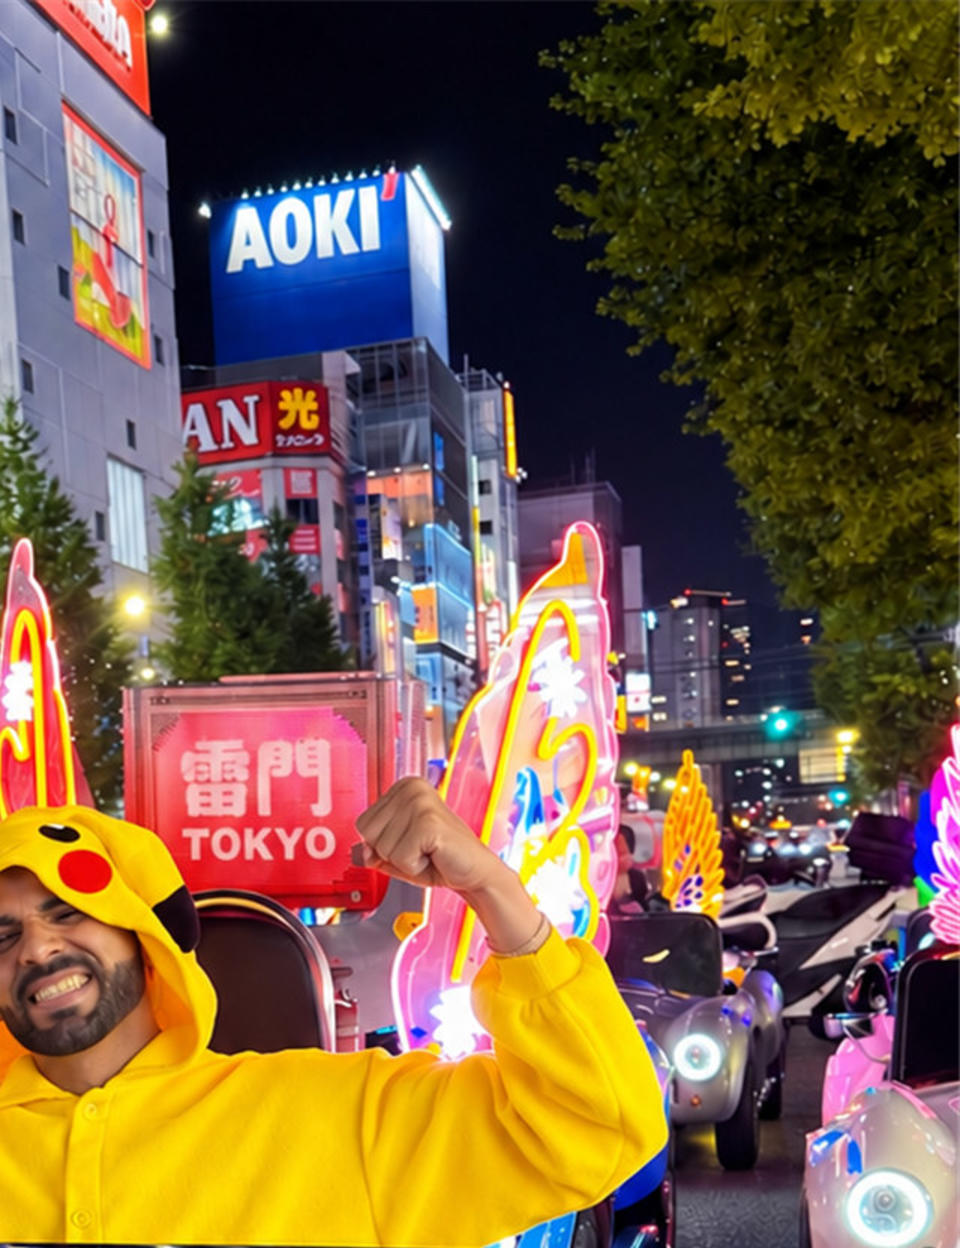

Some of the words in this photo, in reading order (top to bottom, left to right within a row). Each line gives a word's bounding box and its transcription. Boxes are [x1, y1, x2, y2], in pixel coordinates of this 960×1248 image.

[226, 185, 381, 274] AOKI
[278, 387, 320, 430] 光
[181, 738, 333, 818] 雷門
[181, 826, 337, 861] TOKYO
